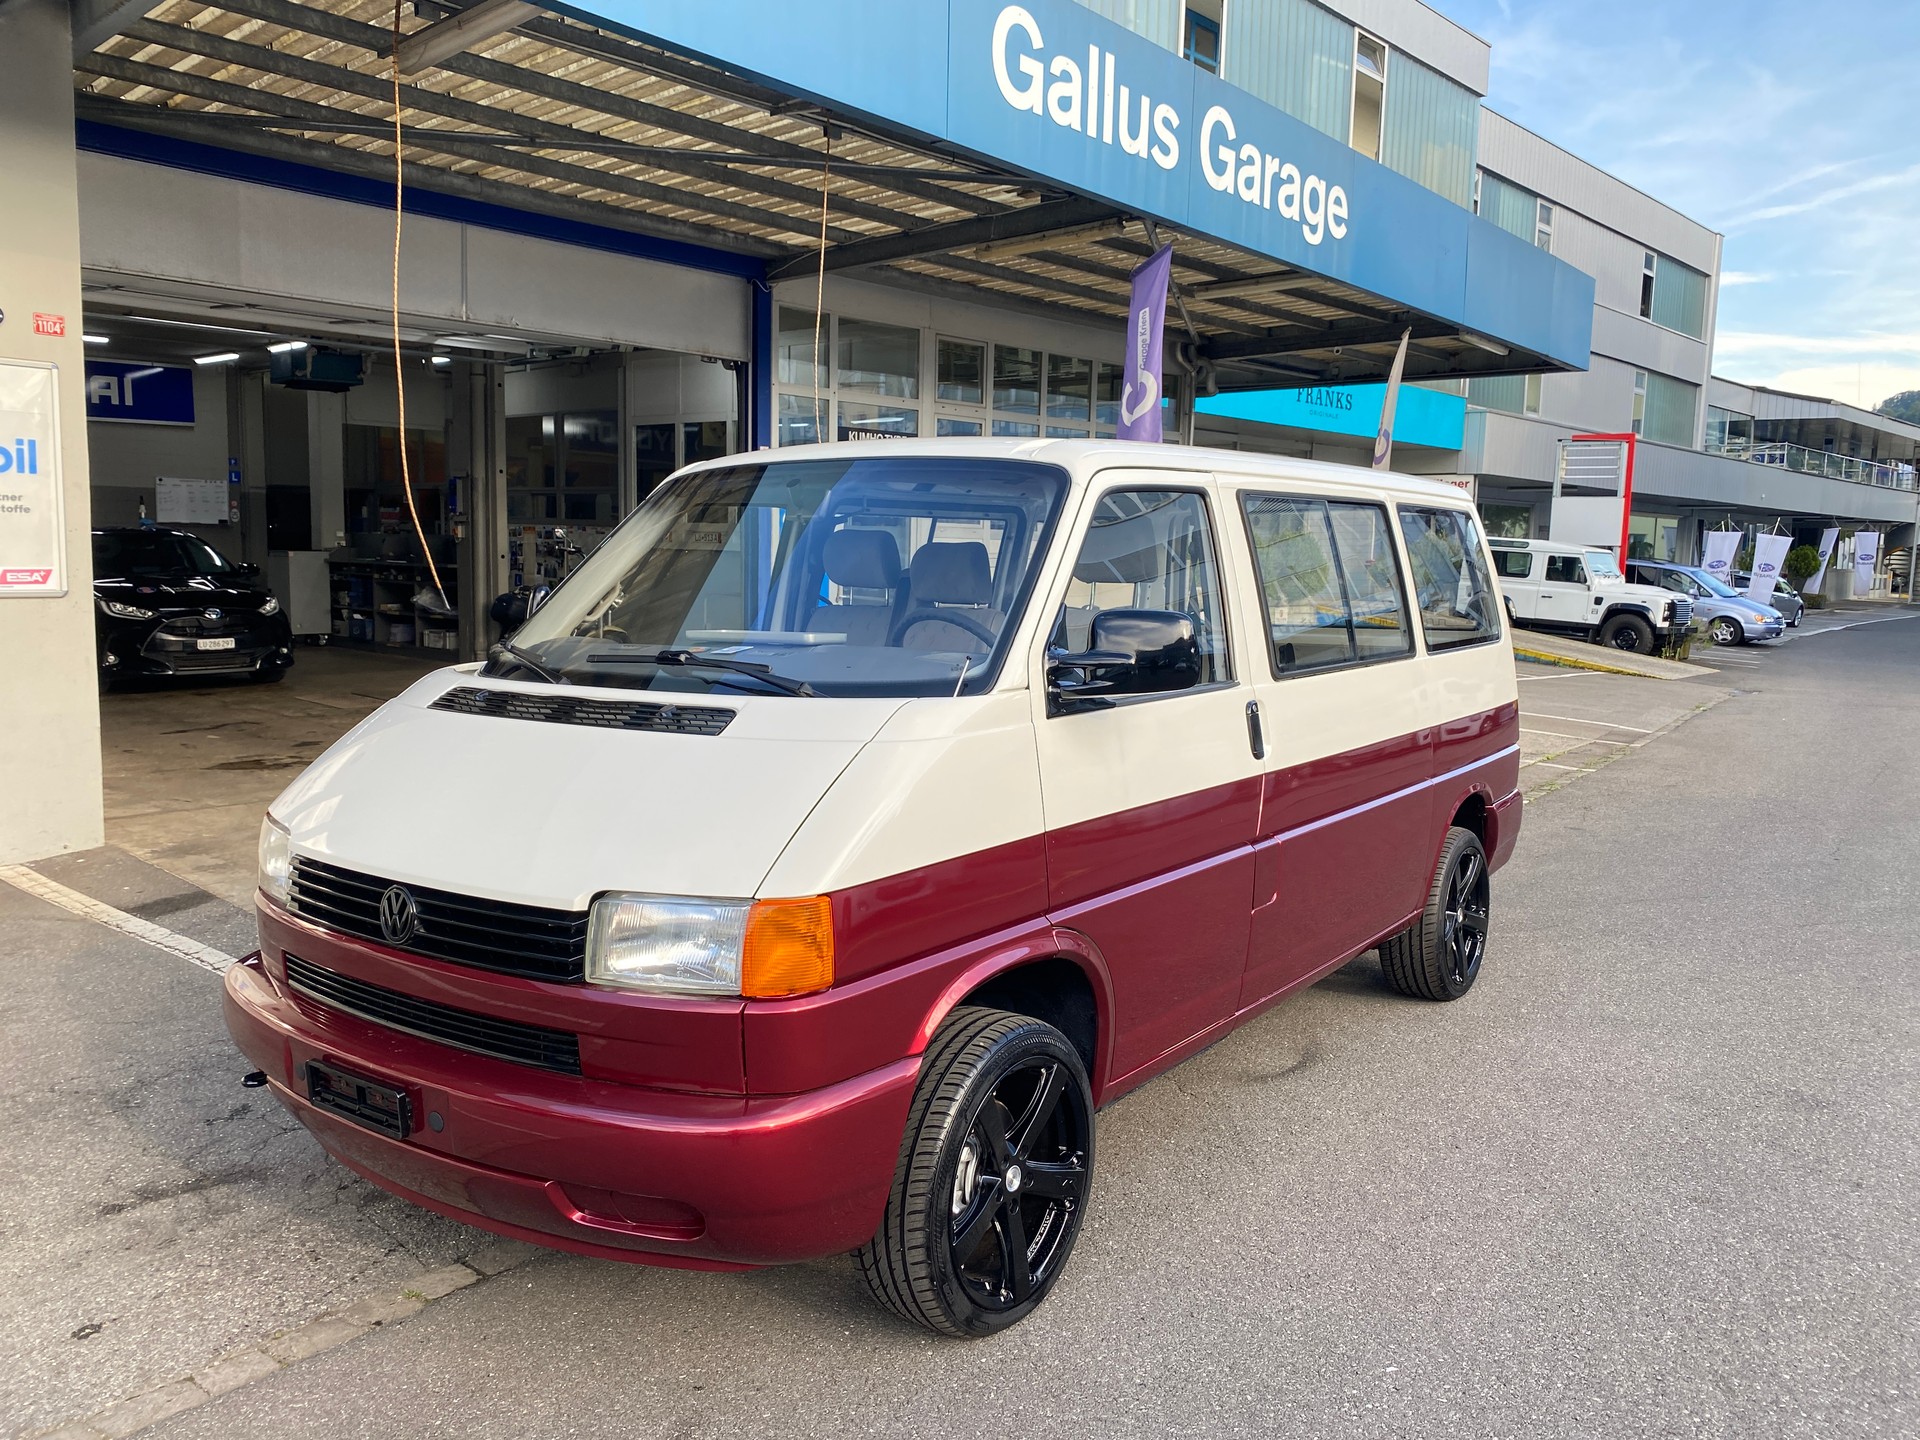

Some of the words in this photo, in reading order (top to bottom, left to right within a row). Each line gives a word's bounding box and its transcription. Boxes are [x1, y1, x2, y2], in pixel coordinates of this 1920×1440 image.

[991, 5, 1180, 170] Gallus
[1200, 105, 1348, 245] Garage
[38, 320, 61, 334] 1104
[1140, 309, 1148, 337] Kriens
[1296, 387, 1353, 411] FRANKS
